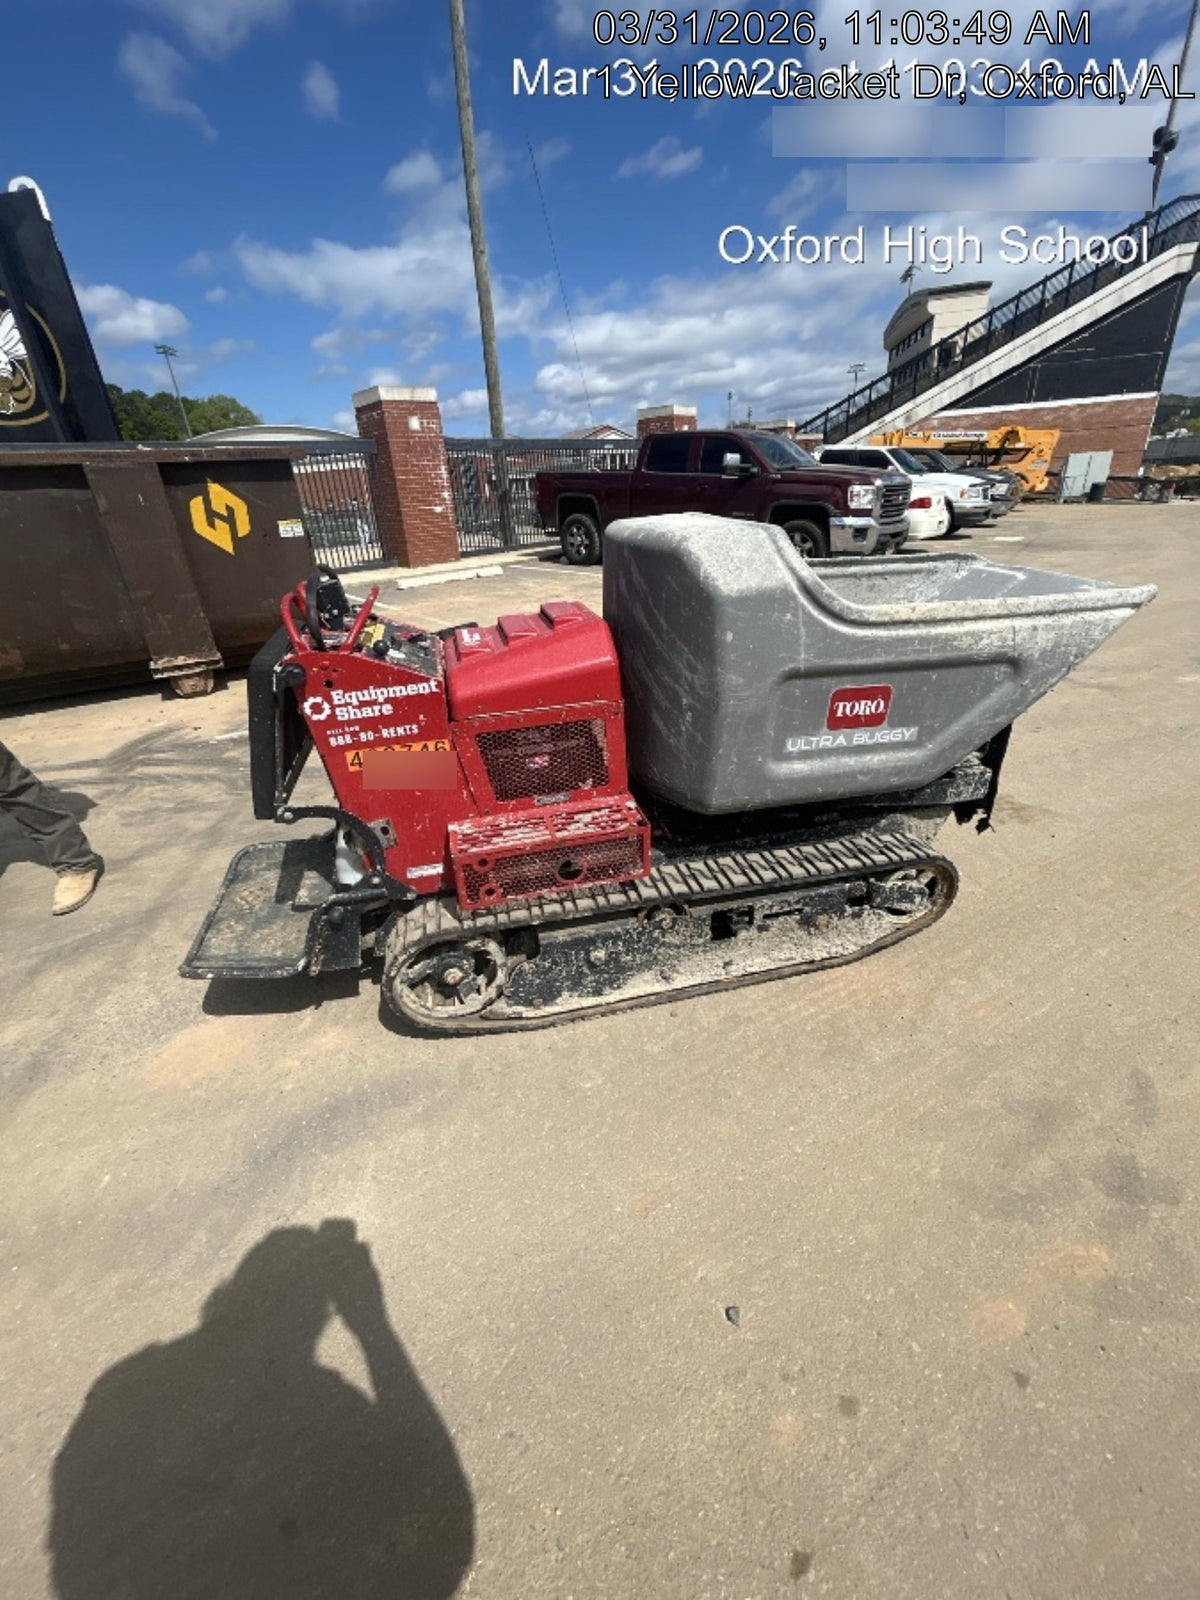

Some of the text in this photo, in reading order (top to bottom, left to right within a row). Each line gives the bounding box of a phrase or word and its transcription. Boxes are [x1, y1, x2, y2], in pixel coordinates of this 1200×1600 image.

[330, 678, 439, 706] Equipment
[335, 703, 393, 721] Share
[834, 698, 886, 717] TORO
[328, 724, 419, 748] 888-80-RENTS
[786, 728, 914, 751] ULTRA BUGGY
